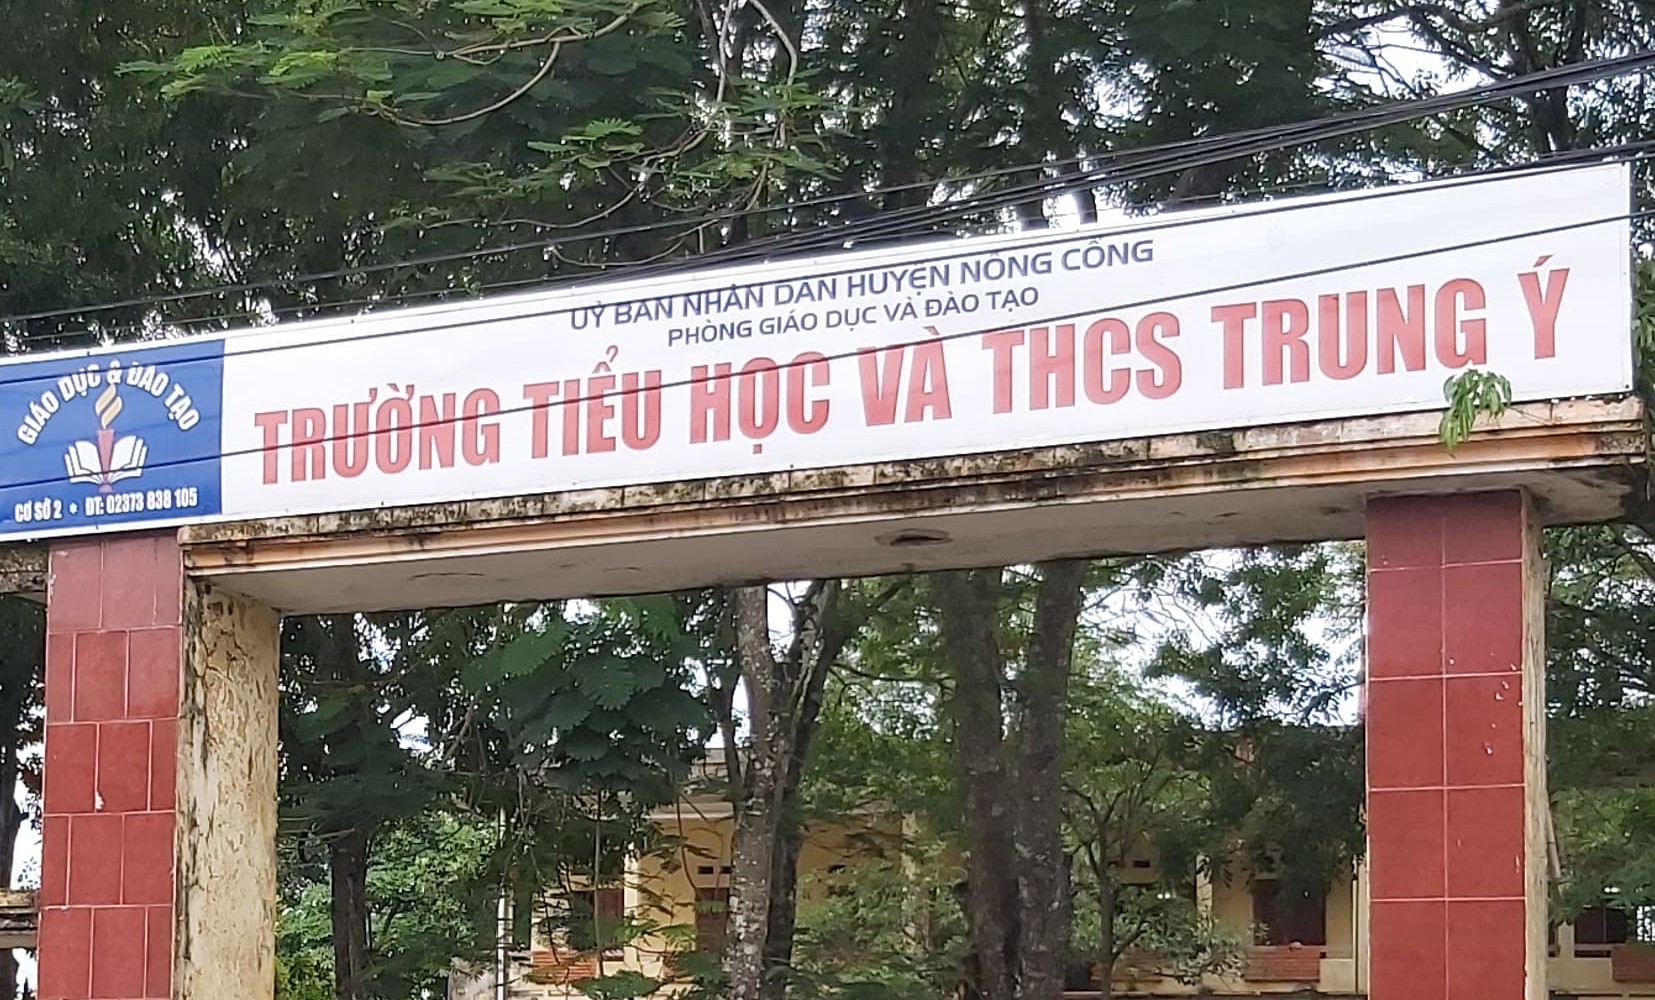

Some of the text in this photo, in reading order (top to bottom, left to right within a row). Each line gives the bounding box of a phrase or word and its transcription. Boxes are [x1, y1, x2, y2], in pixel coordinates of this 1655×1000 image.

[614, 297, 673, 326] BAN
[683, 284, 764, 317] NHÂN
[847, 262, 950, 298] HUYỆN
[960, 252, 1053, 284] NÔNG
[1062, 239, 1154, 271] CÔNG
[668, 286, 1040, 347] PHÒNG GIÁO DỤC VÀ ĐÀO TẠO
[17, 390, 60, 445] GIÁO
[57, 363, 102, 401] DỤC
[106, 359, 123, 385] &
[164, 383, 201, 431] TẠO
[254, 255, 1571, 486] TRƯỜNG TIỂU HỌC VÀ THCS TRUNG Ý
[53, 499, 63, 520] 2
[106, 492, 144, 514] 02373
[146, 489, 172, 510] 838
[174, 487, 198, 508] 105
